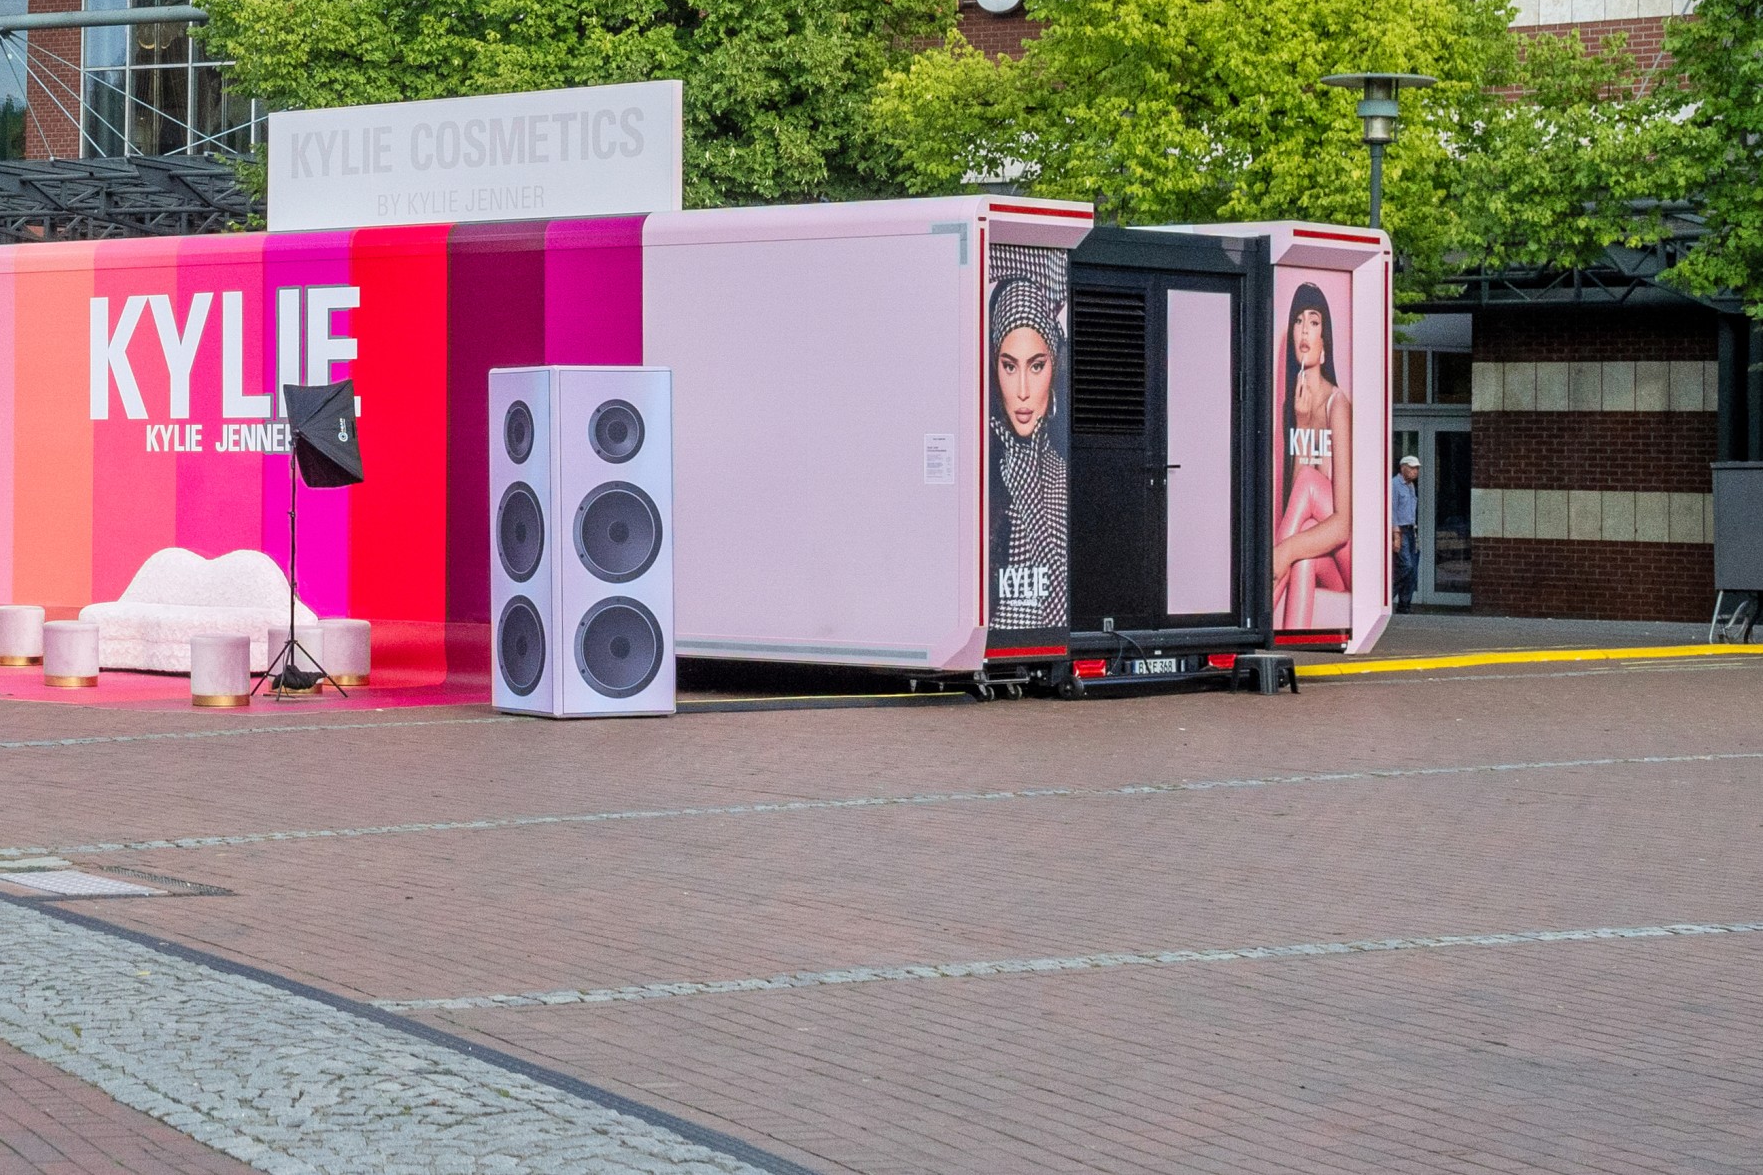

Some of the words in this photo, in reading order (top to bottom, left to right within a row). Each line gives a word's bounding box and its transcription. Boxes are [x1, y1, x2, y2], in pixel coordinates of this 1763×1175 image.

[291, 126, 392, 179] KYLIE
[410, 107, 645, 171] COSMETICS
[377, 193, 401, 217] BY
[407, 190, 458, 215] KYLIE
[465, 185, 544, 213] JENNER
[89, 286, 362, 420] KYLIE
[146, 424, 203, 452] KYLIE
[1290, 428, 1332, 457] KYLIE
[999, 567, 1049, 598] KYLIE
